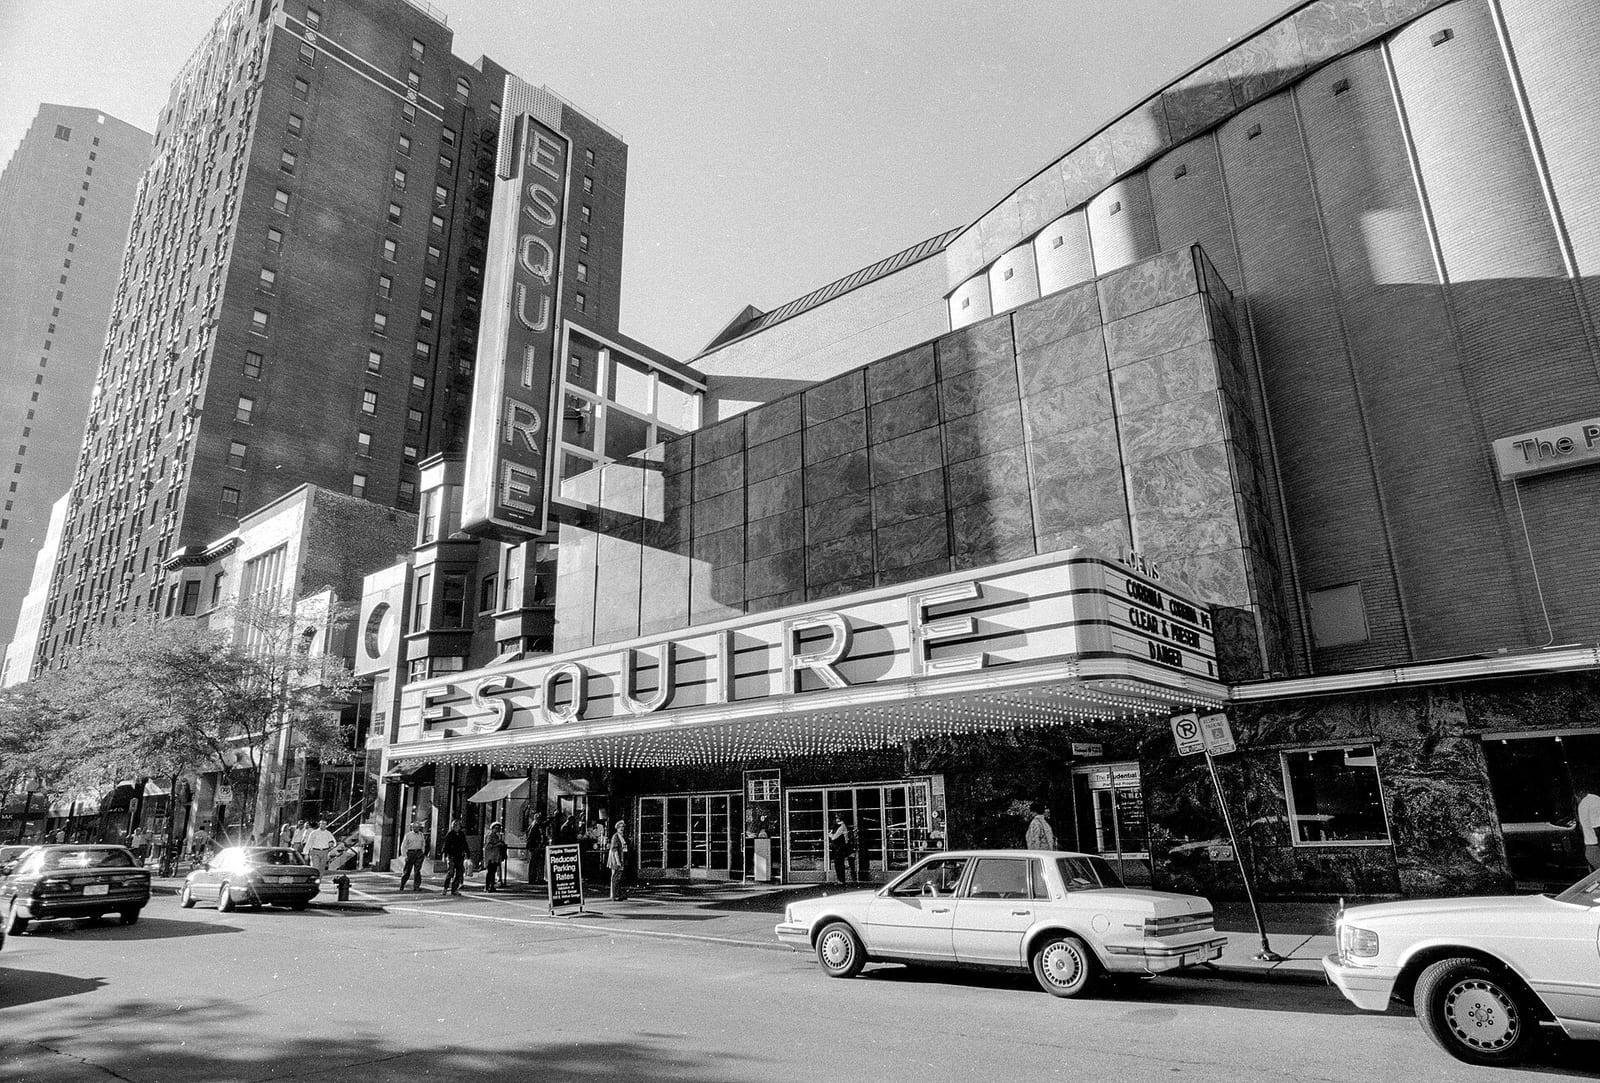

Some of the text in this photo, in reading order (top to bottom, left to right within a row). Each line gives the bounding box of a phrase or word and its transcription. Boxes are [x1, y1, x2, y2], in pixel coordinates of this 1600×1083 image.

[498, 128, 562, 516] ESQUIRE
[1513, 437, 1575, 461] The
[1129, 607, 1201, 650] CLEAR & PRESENT
[419, 581, 989, 742] ESQUIRE
[1148, 640, 1183, 668] DANGER
[1106, 772, 1138, 780] Pudential
[550, 855, 577, 863] Reduced
[553, 864, 576, 872] Parking
